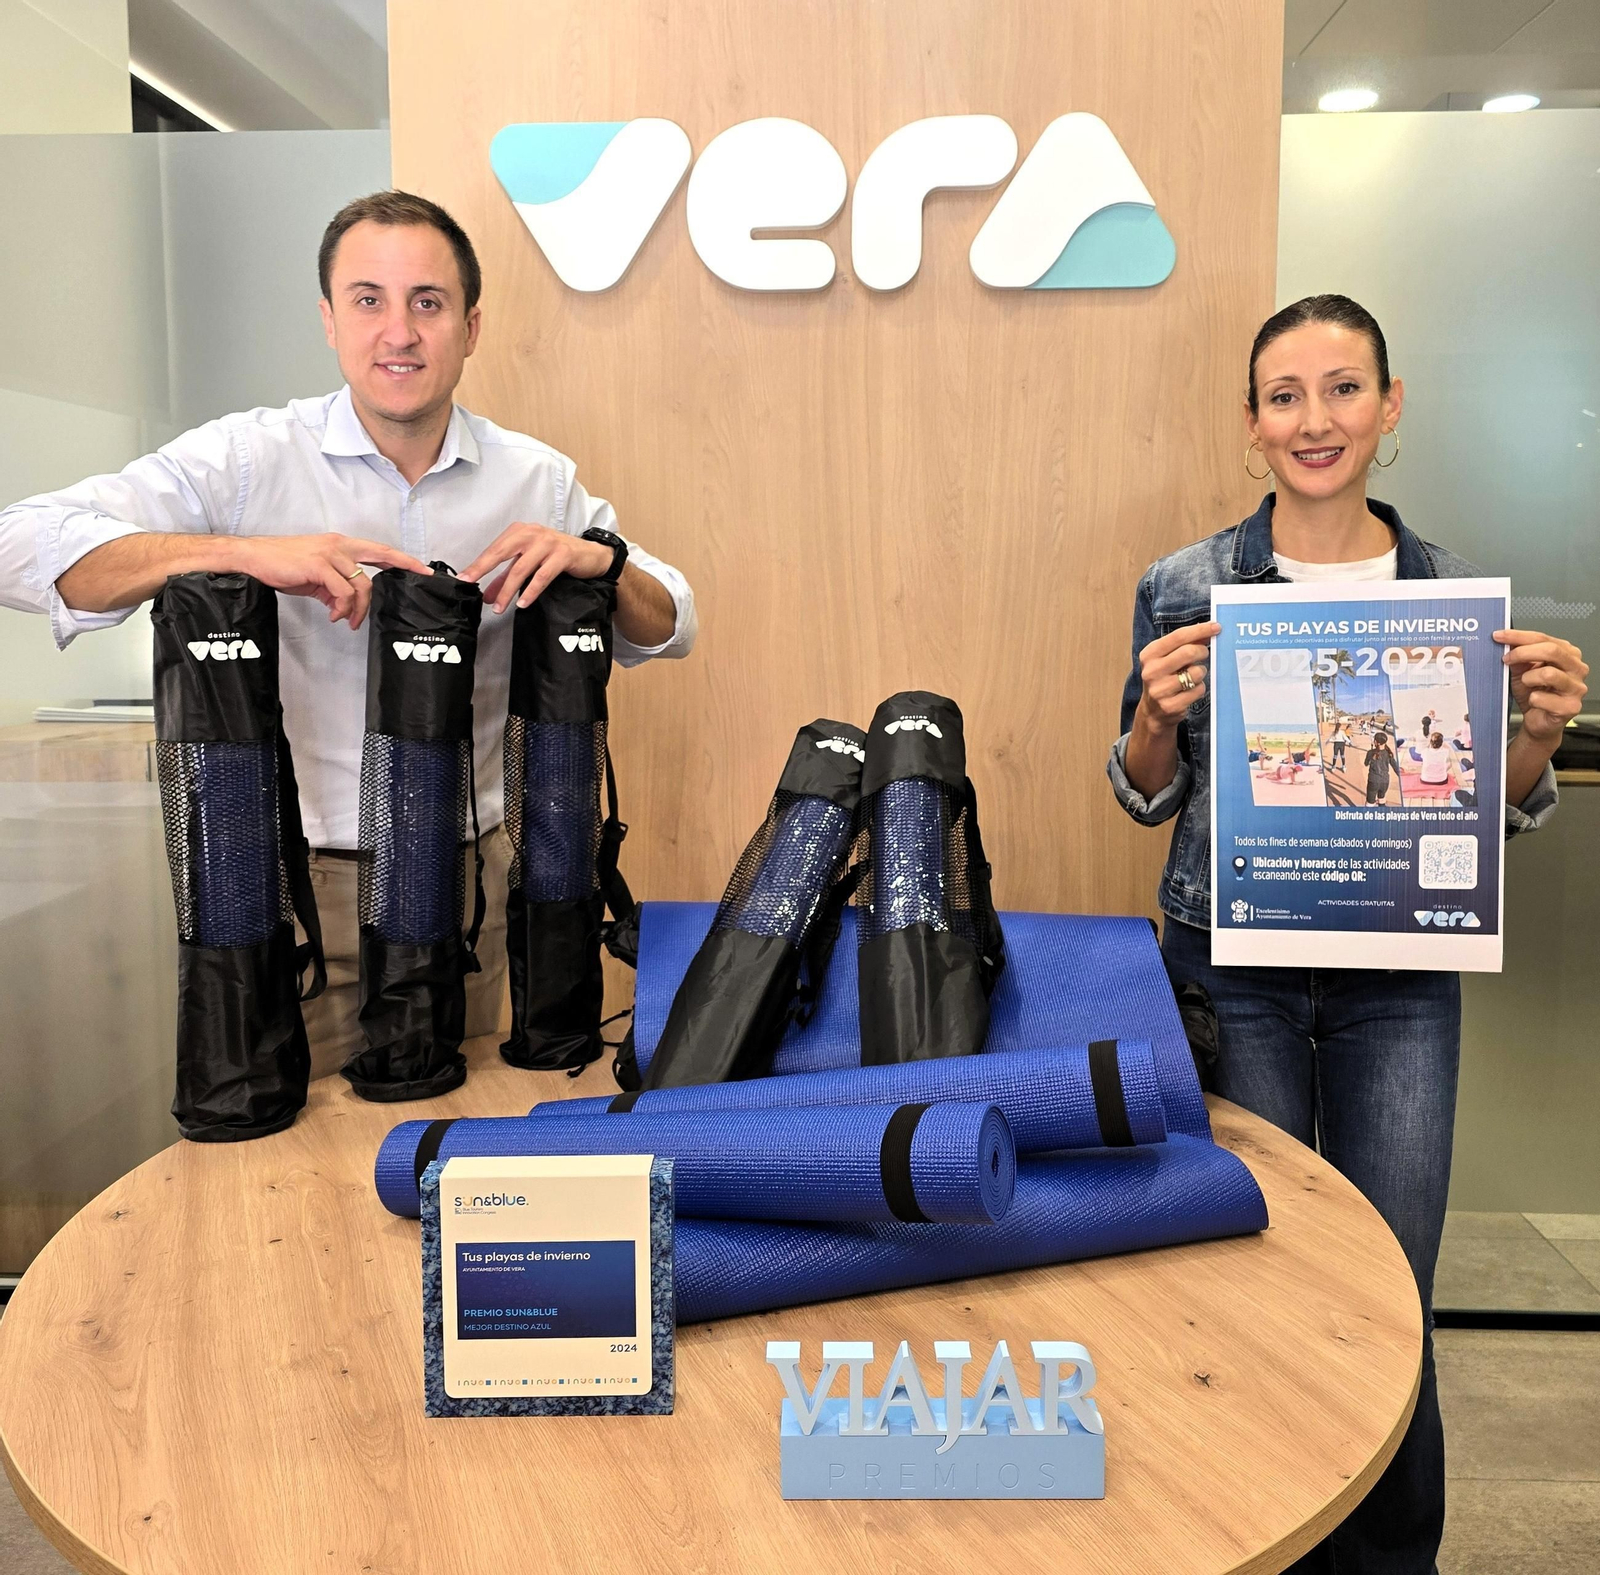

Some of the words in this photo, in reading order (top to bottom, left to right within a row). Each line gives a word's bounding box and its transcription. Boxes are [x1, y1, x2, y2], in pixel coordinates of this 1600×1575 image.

[1236, 622, 1272, 636] TUS
[1277, 620, 1349, 636] PLAYAS
[1354, 619, 1380, 634] DE
[1384, 618, 1479, 633] INVIERNO
[207, 631, 241, 639] destino
[1237, 646, 1462, 678] 2025-2026
[1335, 810, 1363, 821] Disfruta
[1364, 811, 1374, 821] de
[1375, 811, 1385, 821] las
[1386, 811, 1409, 822] playas
[1410, 811, 1420, 821] de
[1421, 811, 1437, 821] Vera
[1438, 811, 1456, 821] todo
[1456, 811, 1463, 821] el
[1464, 811, 1479, 821] año
[1234, 836, 1256, 847] Todos
[1257, 837, 1268, 847] los
[1269, 837, 1288, 847] fines
[1289, 837, 1298, 847] de
[1299, 838, 1328, 848] semana
[1330, 837, 1364, 849] (sábados
[1365, 839, 1370, 849] y
[1371, 838, 1412, 850] domingos)
[1253, 857, 1293, 869] Ubicación
[1294, 859, 1300, 870] y
[1301, 857, 1336, 869] horarios
[1338, 858, 1348, 869] de
[1350, 858, 1362, 870] las
[1363, 858, 1410, 870] actividades
[1253, 870, 1301, 881] escaneando
[1302, 871, 1319, 881] este
[1321, 870, 1350, 883] código
[1351, 871, 1367, 882] QR:
[462, 1252, 483, 1262] Tus
[485, 1252, 524, 1264] playas
[526, 1251, 541, 1261] de
[544, 1250, 591, 1261] invierno
[464, 1309, 503, 1317] PREMIO
[505, 1308, 558, 1317] SUN&BLUE
[494, 1323, 529, 1331] DESTINO
[610, 1344, 637, 1353] 2024
[766, 1340, 1104, 1455] VIAJAR
[828, 1463, 1056, 1490] PREMIOS
